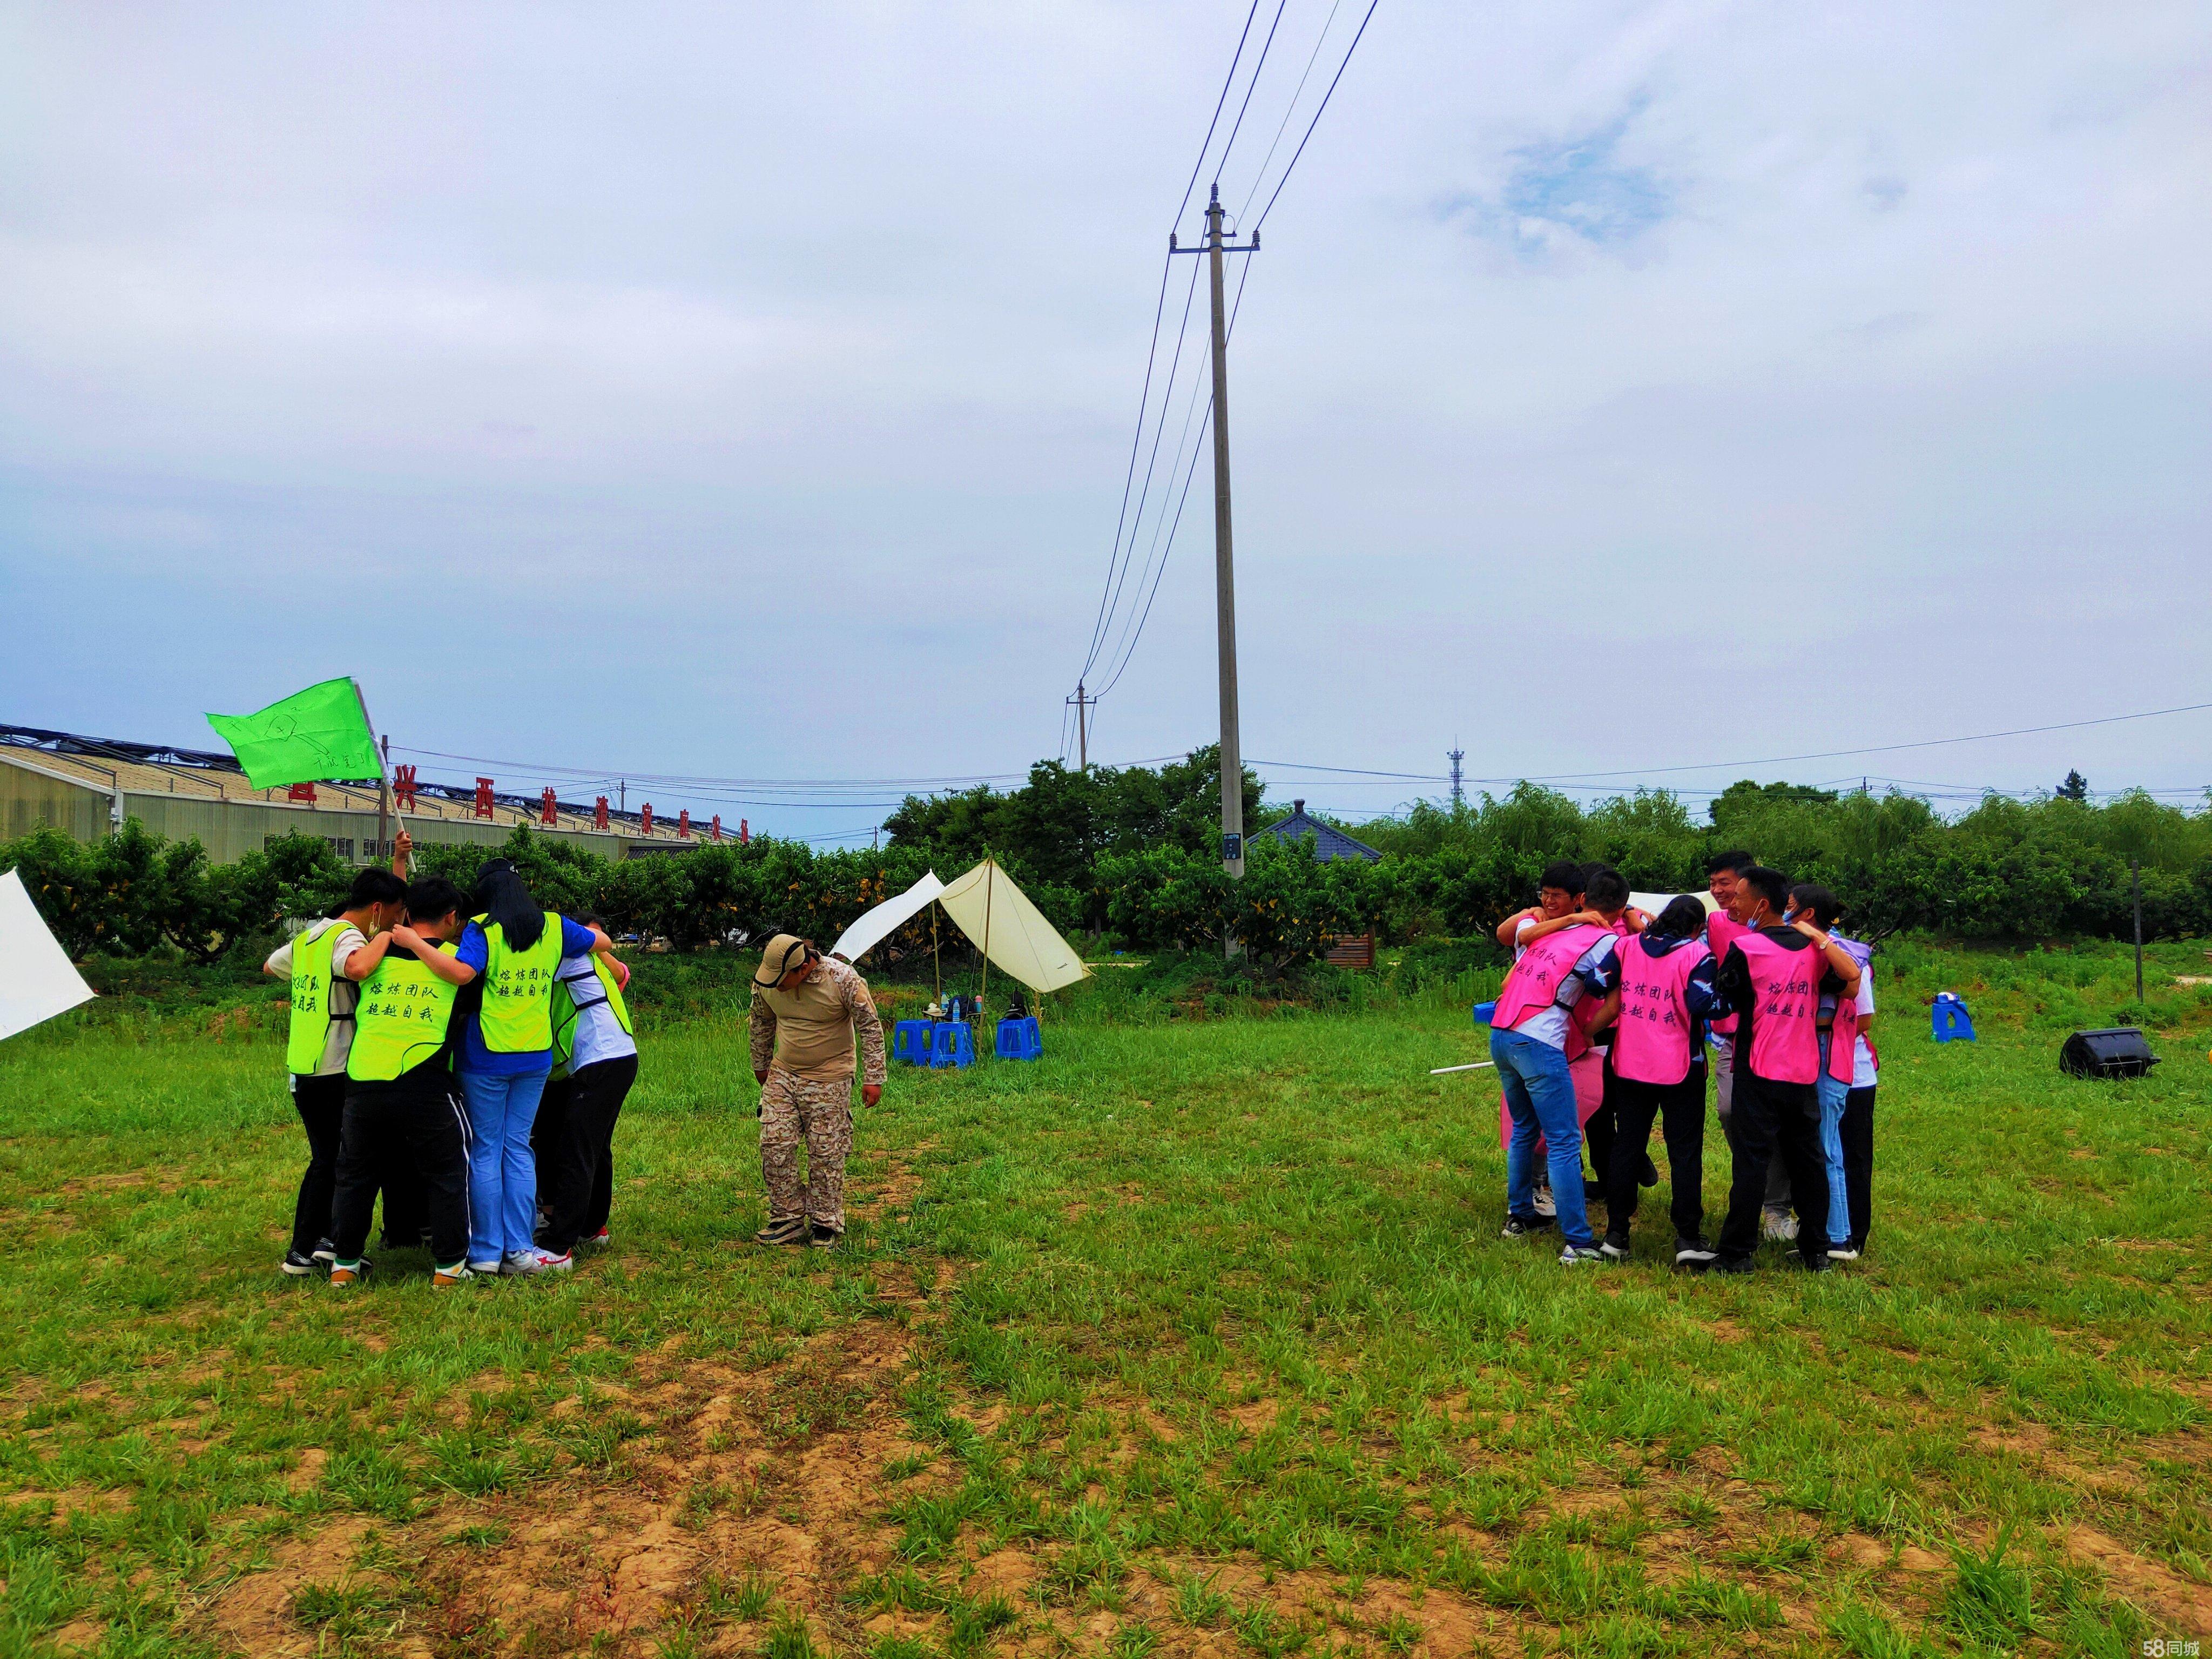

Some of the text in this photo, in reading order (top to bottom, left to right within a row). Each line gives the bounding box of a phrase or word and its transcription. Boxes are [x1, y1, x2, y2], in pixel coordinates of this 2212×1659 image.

[499, 967, 551, 981] 熔炼团队
[369, 982, 439, 999] 熔炼团队
[496, 982, 550, 997] 超越自我
[366, 1002, 434, 1023] 超越自我
